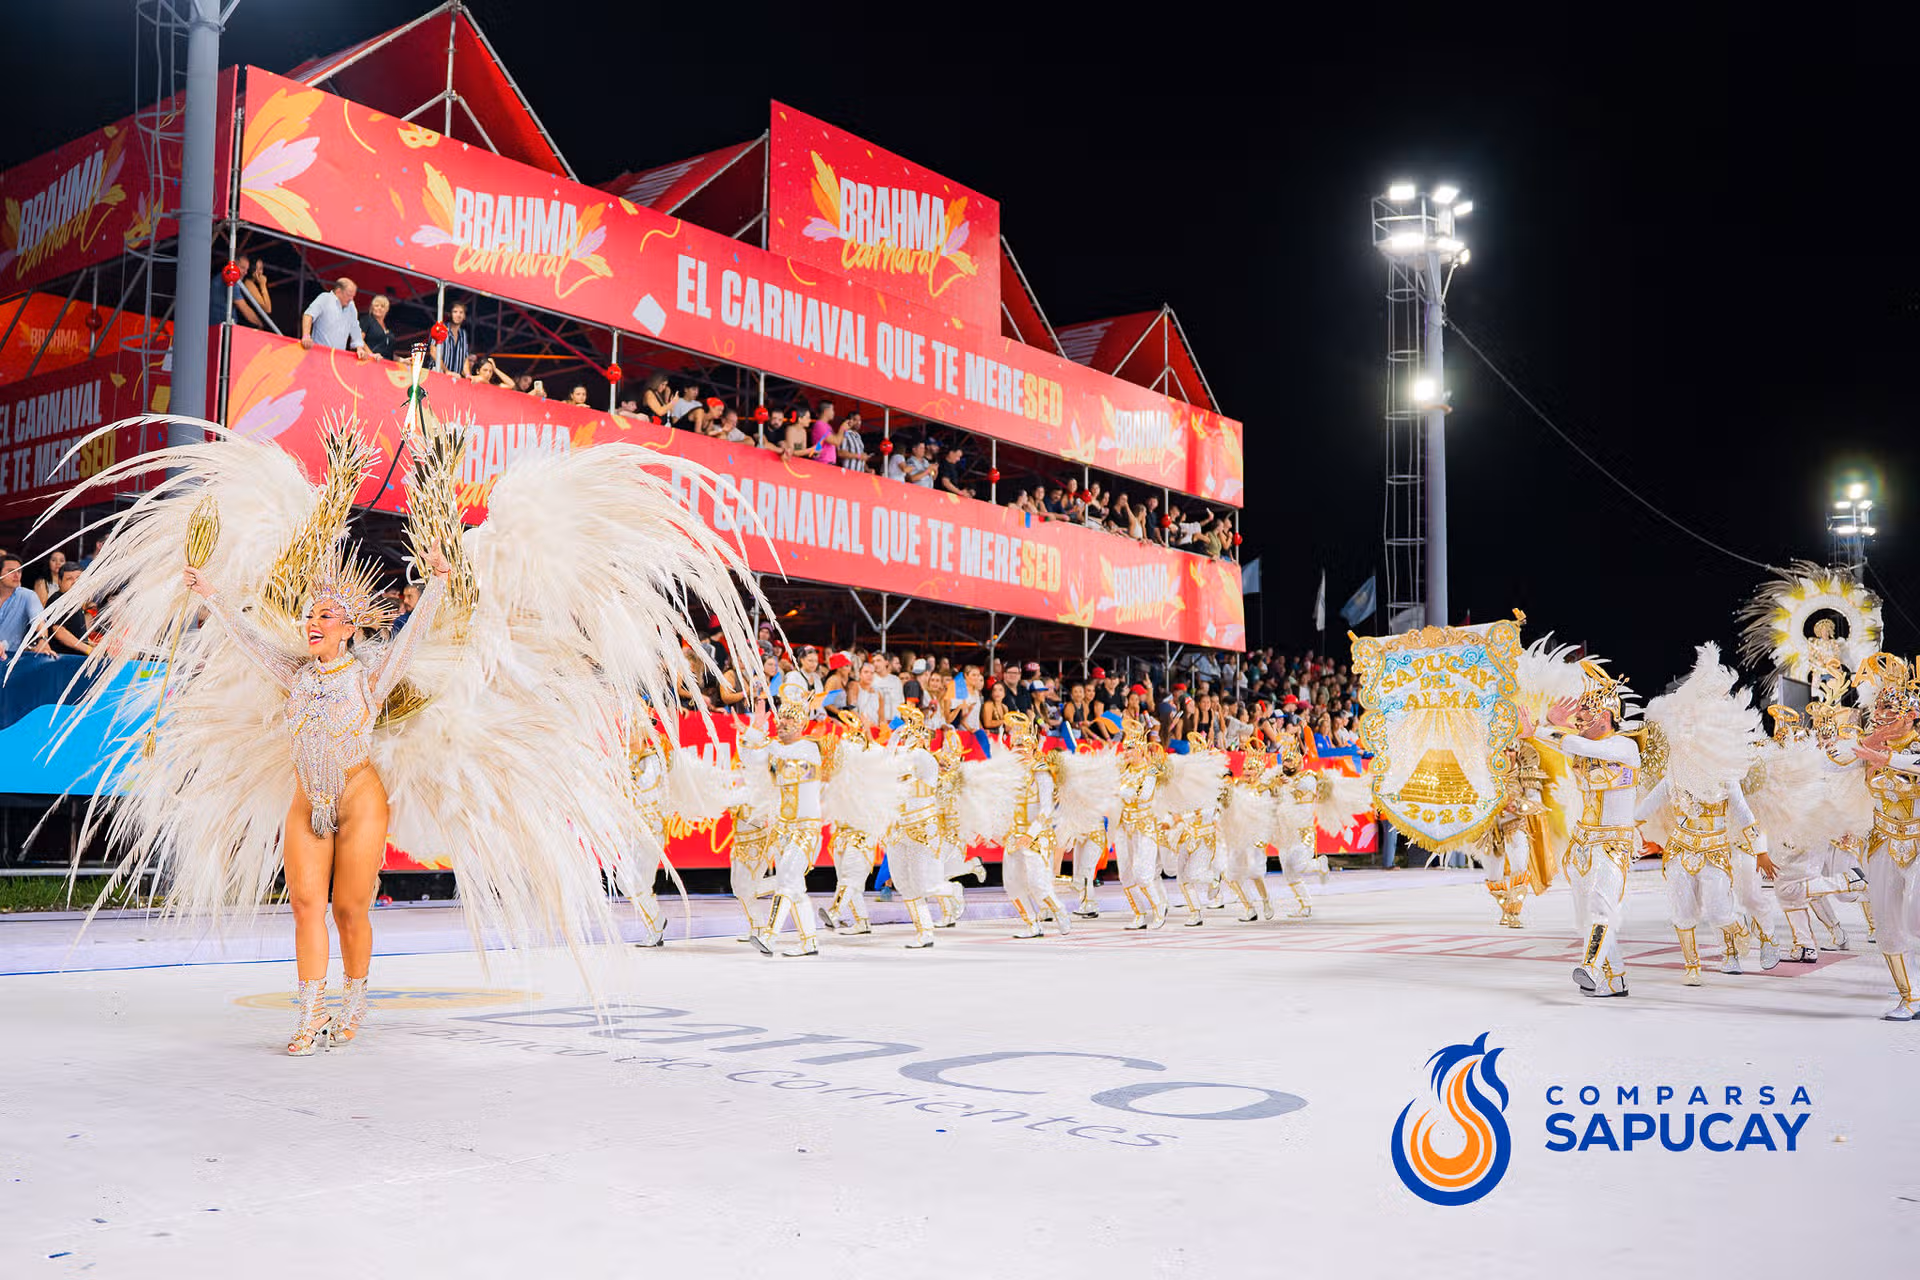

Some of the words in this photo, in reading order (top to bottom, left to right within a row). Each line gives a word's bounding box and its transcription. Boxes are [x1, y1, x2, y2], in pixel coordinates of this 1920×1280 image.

[17, 150, 105, 256] BRAHMA
[452, 186, 579, 260] BRAHMA
[839, 176, 948, 257] BRAHMA
[677, 254, 712, 319] EL
[721, 269, 869, 367] CARNAVAL
[876, 321, 925, 384] QUE
[931, 339, 959, 396] TE
[964, 351, 1063, 429] MERESED
[14, 381, 102, 444] CARNAVAL
[1114, 409, 1173, 450] BRAHMA
[13, 447, 32, 493] TE
[33, 431, 117, 488] MERESED
[713, 473, 865, 555] CARNAVAL
[871, 506, 922, 566] QUE
[926, 518, 954, 572] TE
[960, 525, 1062, 593] MERESED
[1113, 562, 1171, 607] BRAHMA
[1381, 652, 1497, 694] SAPUCAY
[1402, 691, 1481, 711] ALMA
[1420, 673, 1457, 691] DEL
[1401, 803, 1475, 826] 2026
[408, 1027, 609, 1057] Banco
[613, 1056, 713, 1071] de
[725, 1069, 1179, 1148] Corrientes
[447, 1002, 1310, 1121] BanCo
